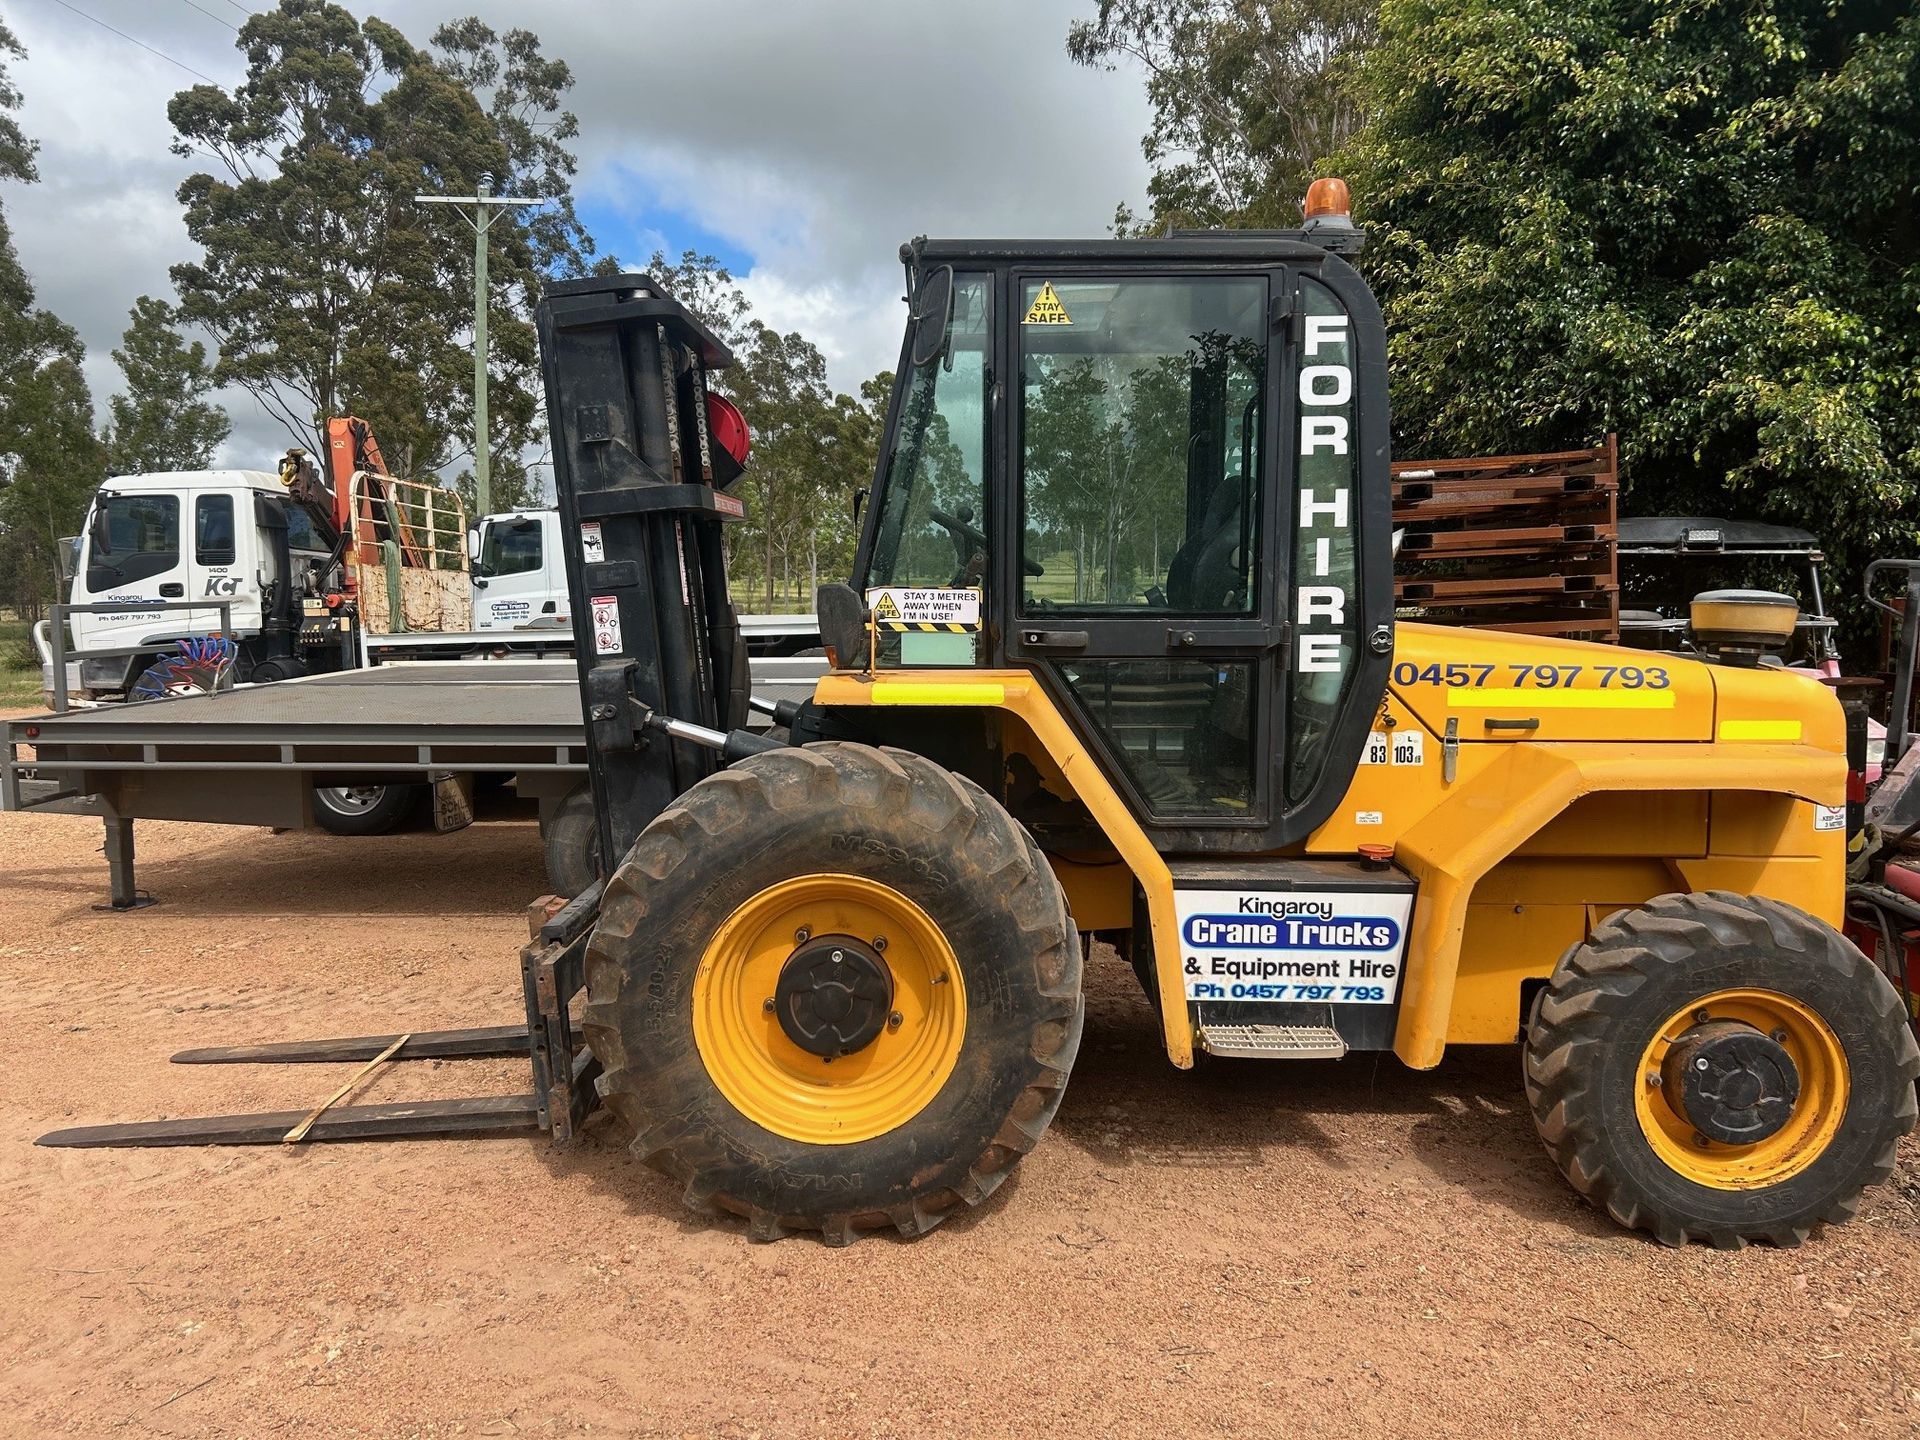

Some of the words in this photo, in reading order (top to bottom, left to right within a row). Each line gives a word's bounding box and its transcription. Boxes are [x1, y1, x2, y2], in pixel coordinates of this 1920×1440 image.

[1034, 302, 1060, 311] STAY
[1028, 312, 1066, 323] SAFE
[1299, 314, 1352, 455] FOR
[204, 577, 244, 596] KCT
[1298, 488, 1349, 673] HIRE
[107, 594, 143, 603] Kingaroy
[903, 592, 928, 600] STAY
[929, 592, 935, 600] 3
[937, 592, 977, 601] METRES
[903, 602, 932, 610] AWAY
[932, 602, 962, 611] WHEN
[903, 612, 917, 620] I'M
[919, 612, 930, 620] IN
[931, 612, 954, 621] USE!
[1393, 662, 1496, 687] 0457
[1508, 664, 1583, 689] 797
[1593, 665, 1671, 690] 793
[1370, 745, 1387, 763] 83
[1394, 745, 1414, 763] 103
[1238, 897, 1334, 919] Kingaroy
[1191, 918, 1278, 944] Crane
[1285, 920, 1390, 946] Trucks
[1184, 956, 1202, 975] &
[1211, 957, 1341, 980] Equipment
[1349, 959, 1397, 978] Hire
[1193, 984, 1225, 998] Ph
[1231, 984, 1289, 999] 0457
[1291, 985, 1337, 1000] 797
[1340, 986, 1385, 1000] 793
